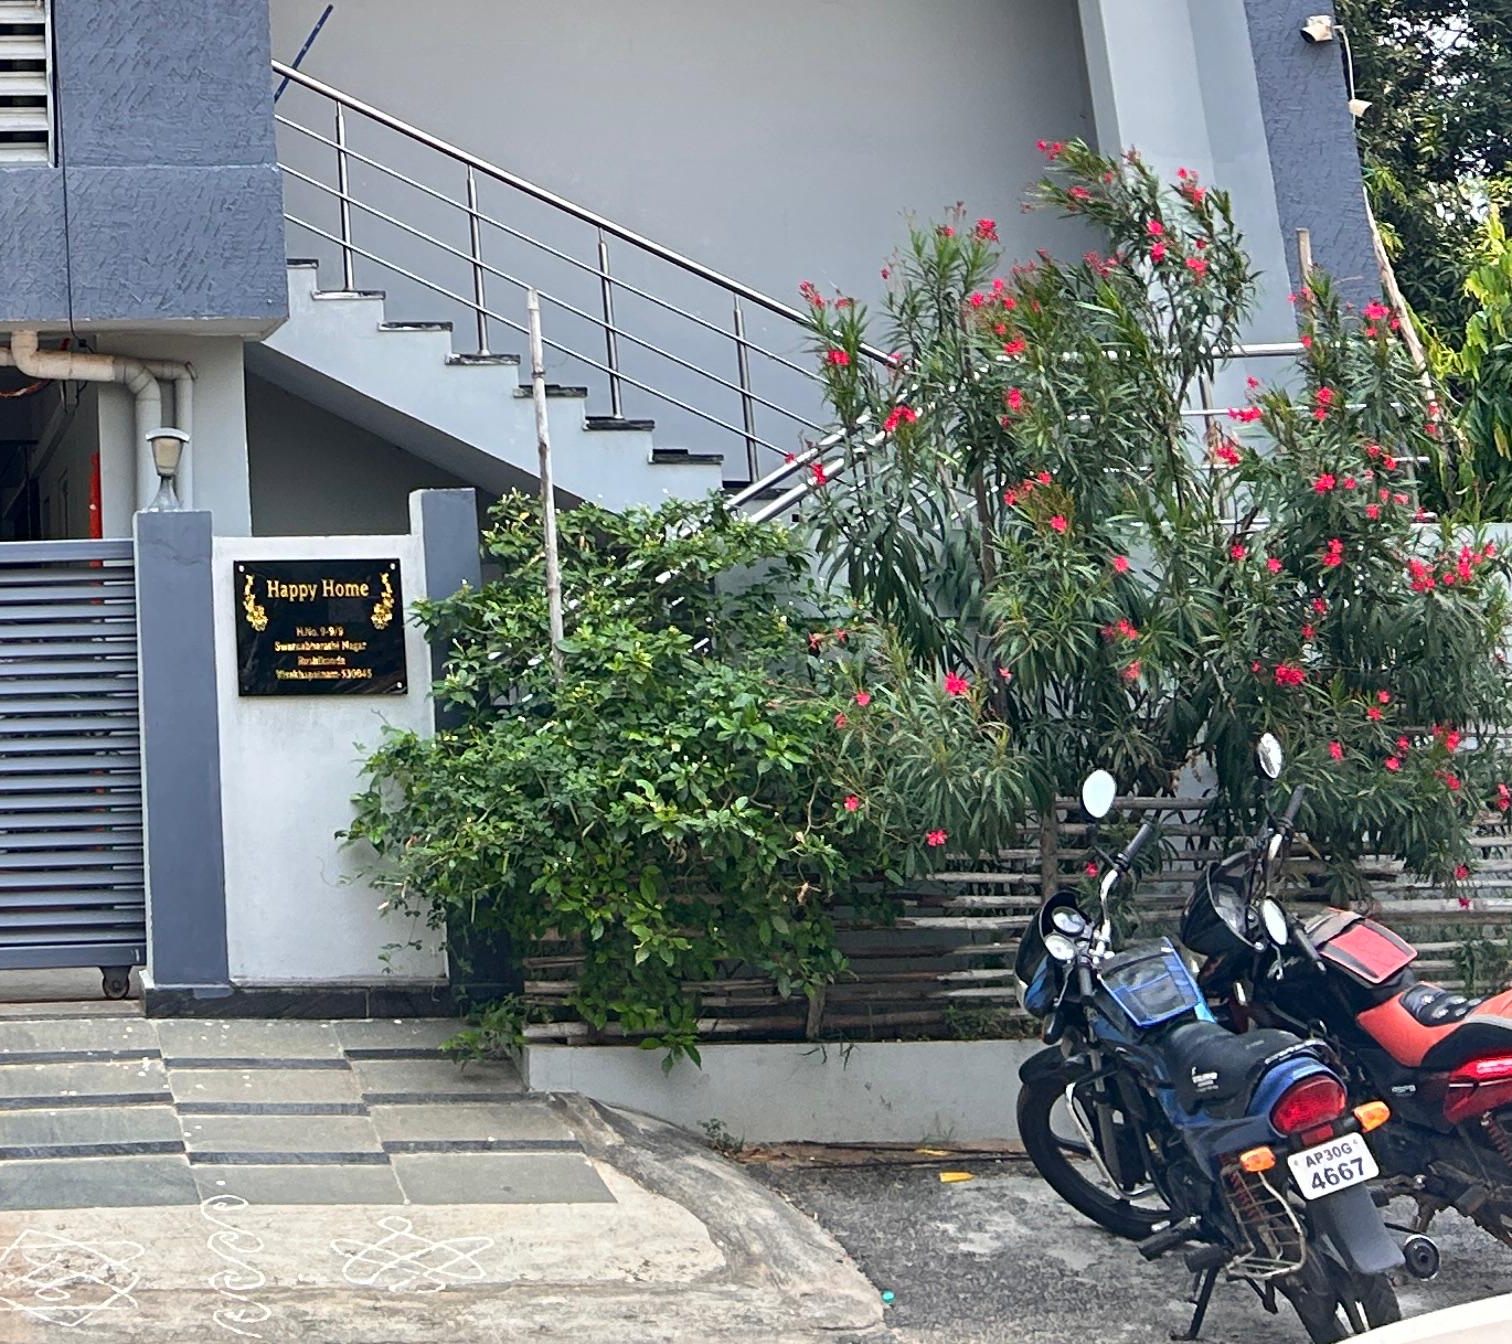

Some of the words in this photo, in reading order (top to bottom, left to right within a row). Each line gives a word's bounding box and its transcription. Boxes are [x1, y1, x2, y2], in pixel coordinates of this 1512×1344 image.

[266, 579, 318, 602] Happy
[321, 578, 370, 597] Home
[1304, 1142, 1353, 1168] AP30G
[1311, 1157, 1364, 1190] 4667
